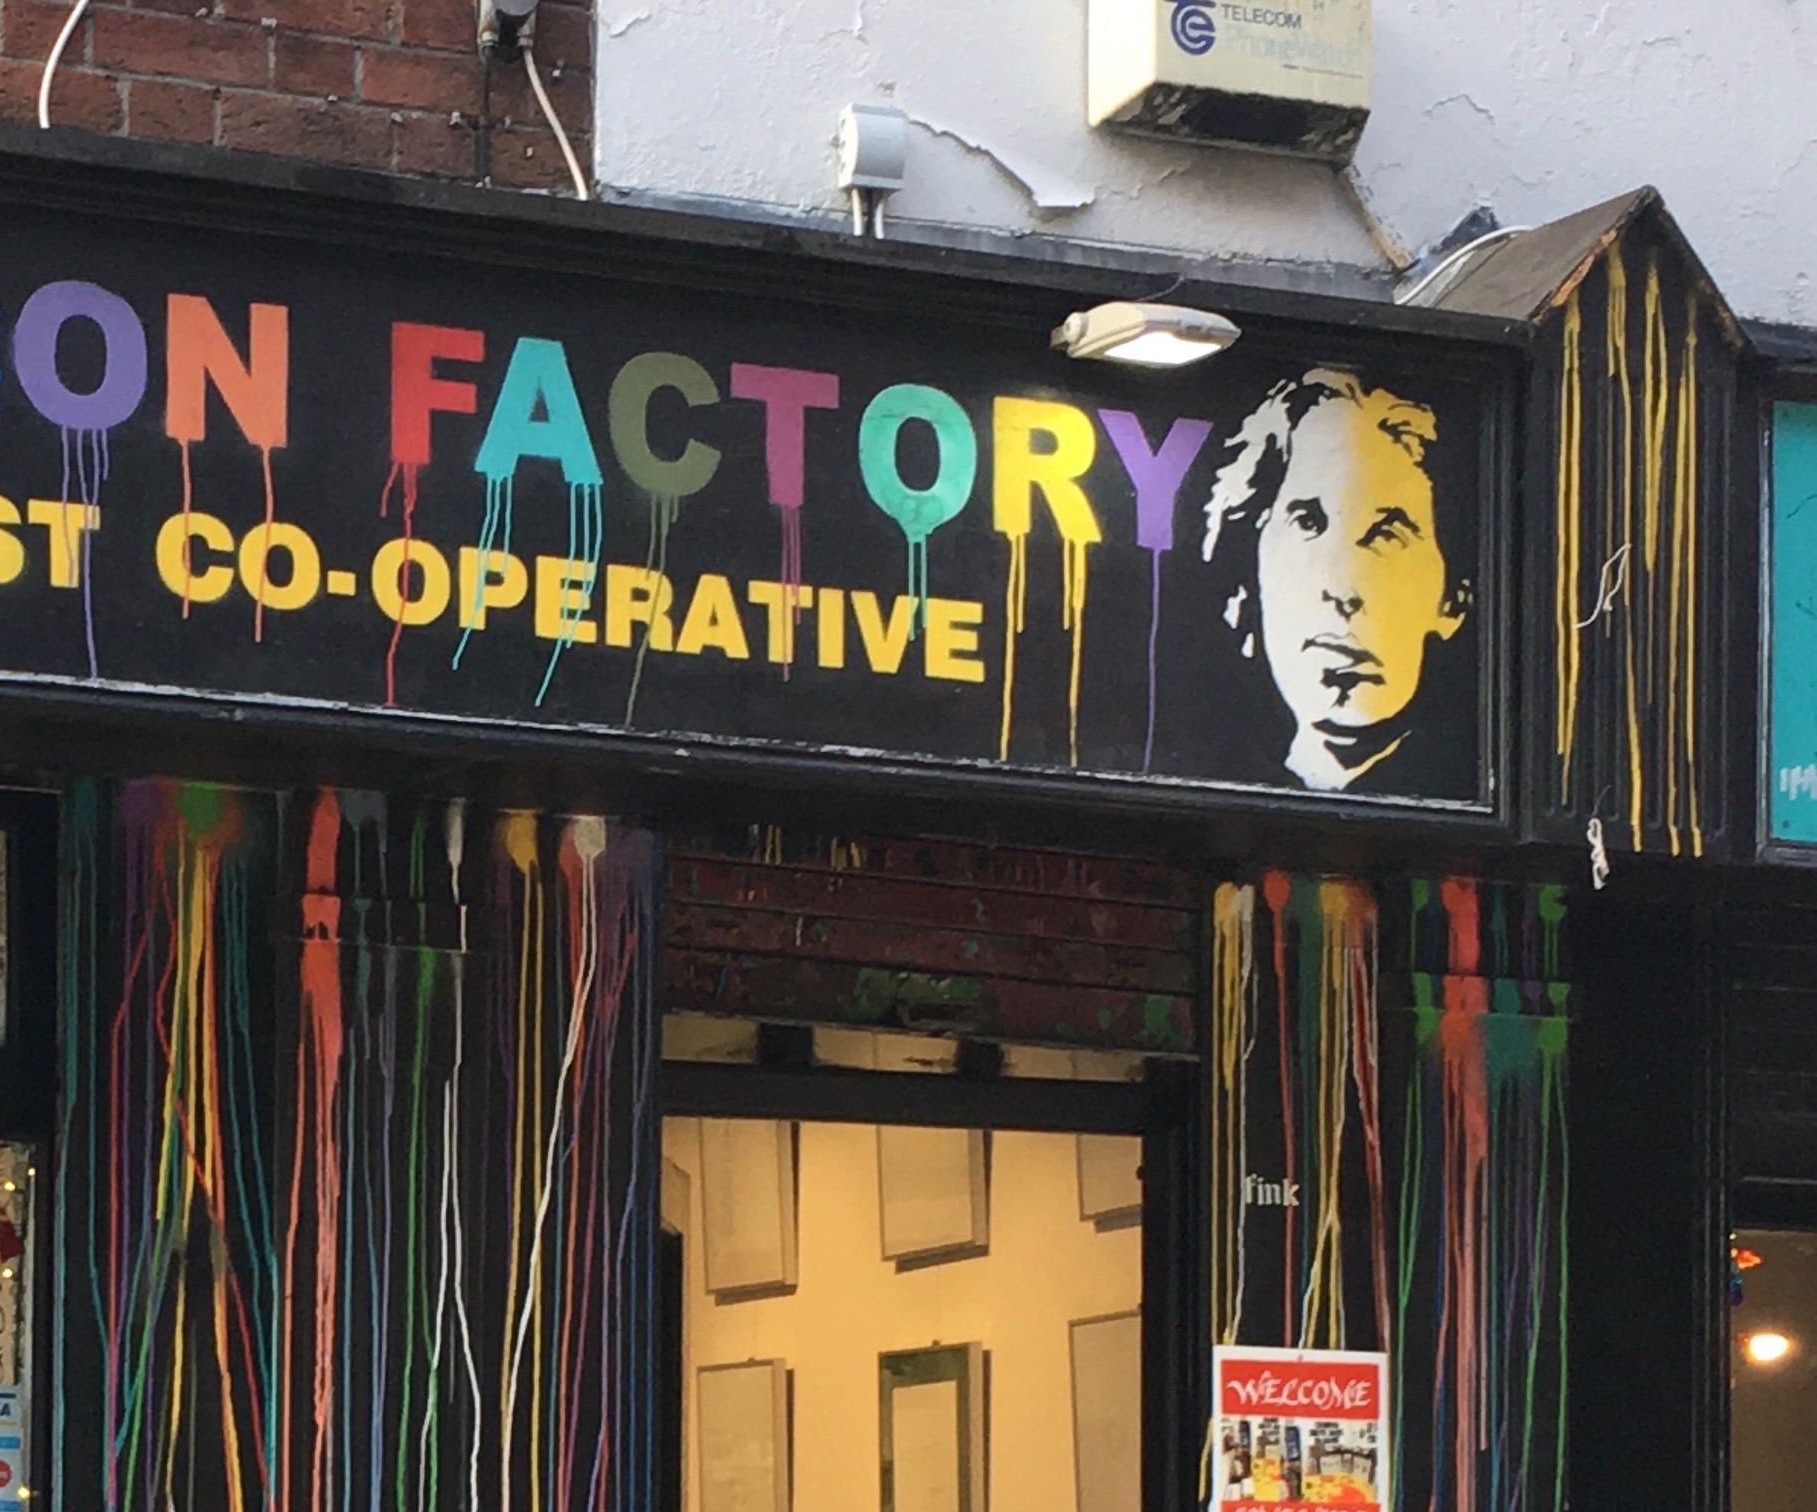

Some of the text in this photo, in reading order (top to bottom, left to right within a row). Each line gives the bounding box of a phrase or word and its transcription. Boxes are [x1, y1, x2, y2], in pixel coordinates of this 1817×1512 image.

[1221, 4, 1303, 29] TELECOM
[390, 321, 1213, 550] FACTORY
[155, 512, 986, 684] CO-OPERATIVE
[1244, 1173, 1300, 1207] fink
[1227, 1370, 1371, 1410] WELCOME
